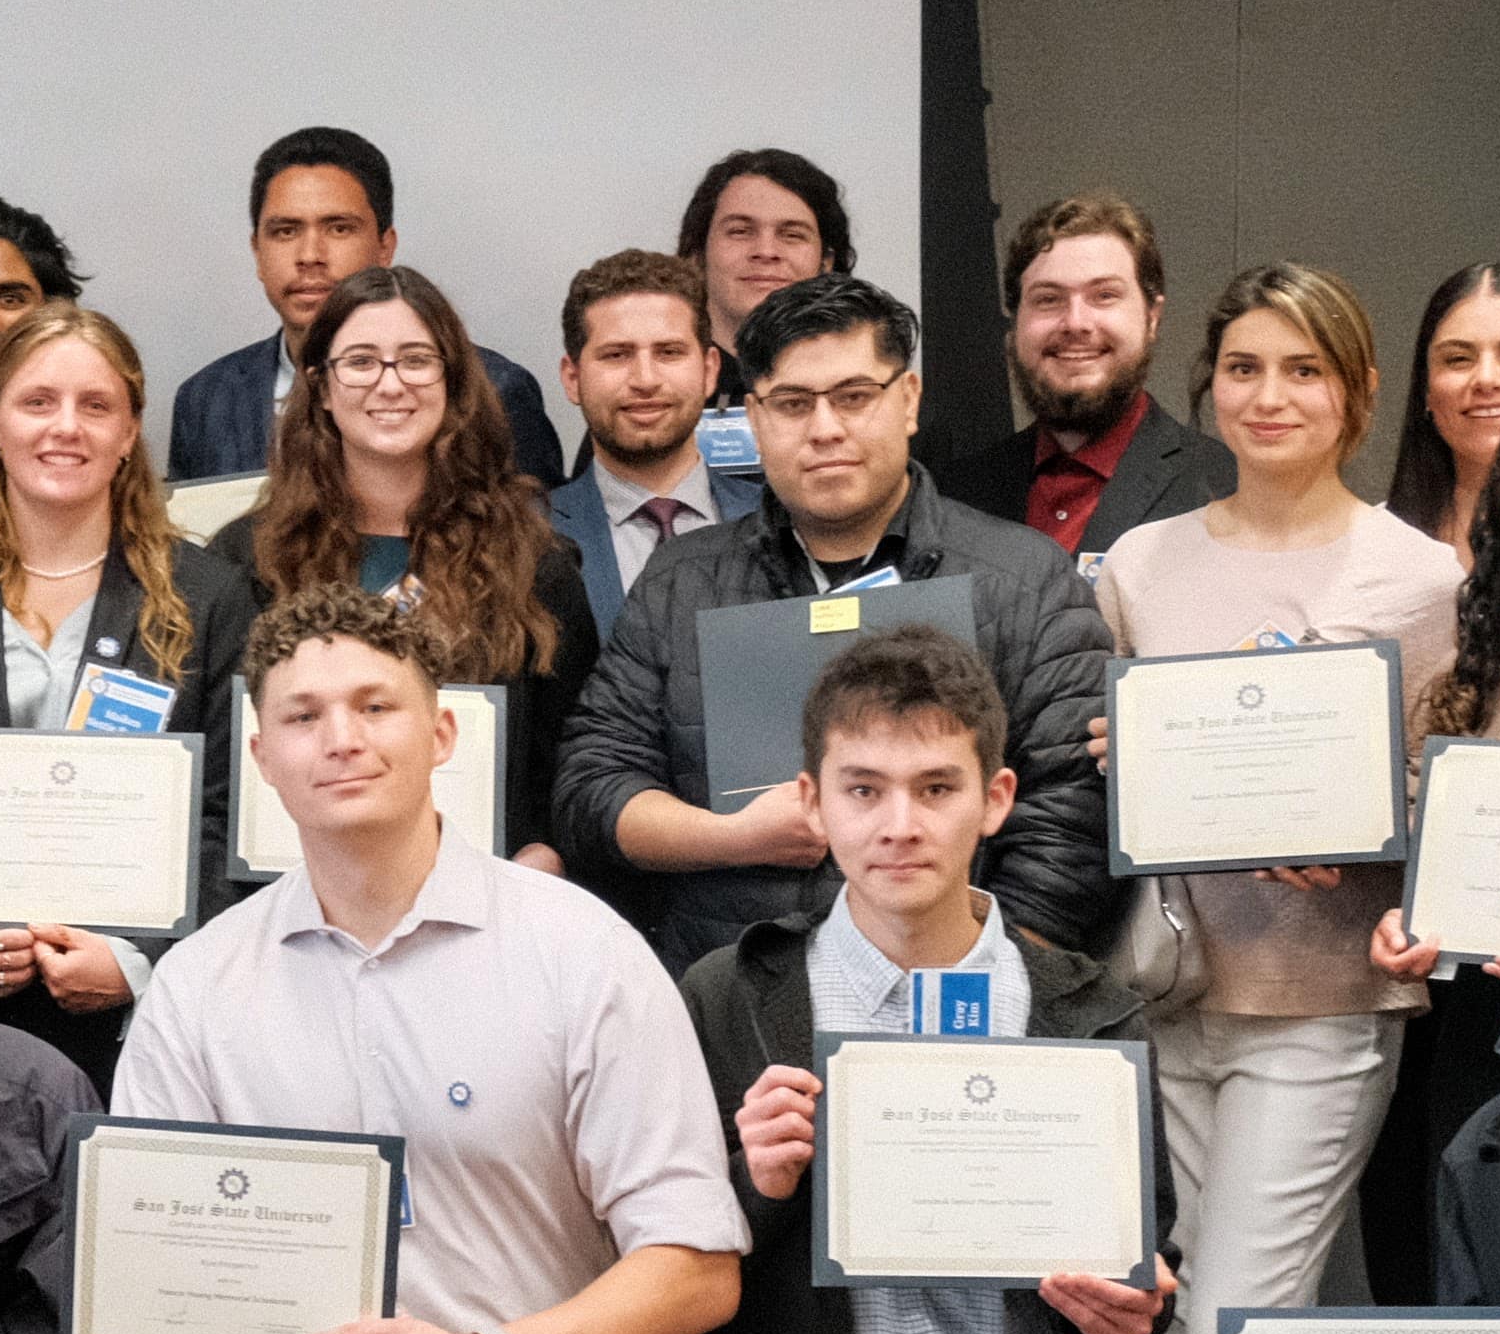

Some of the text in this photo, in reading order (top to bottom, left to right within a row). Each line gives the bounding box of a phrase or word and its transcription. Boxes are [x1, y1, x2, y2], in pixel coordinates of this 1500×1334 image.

[967, 1002, 980, 1027] Kim
[882, 1108, 914, 1121] San
[959, 1108, 998, 1122] State
[1002, 1108, 1081, 1123] University
[133, 1197, 165, 1212] San
[209, 1203, 250, 1219] State
[255, 1206, 333, 1224] University
